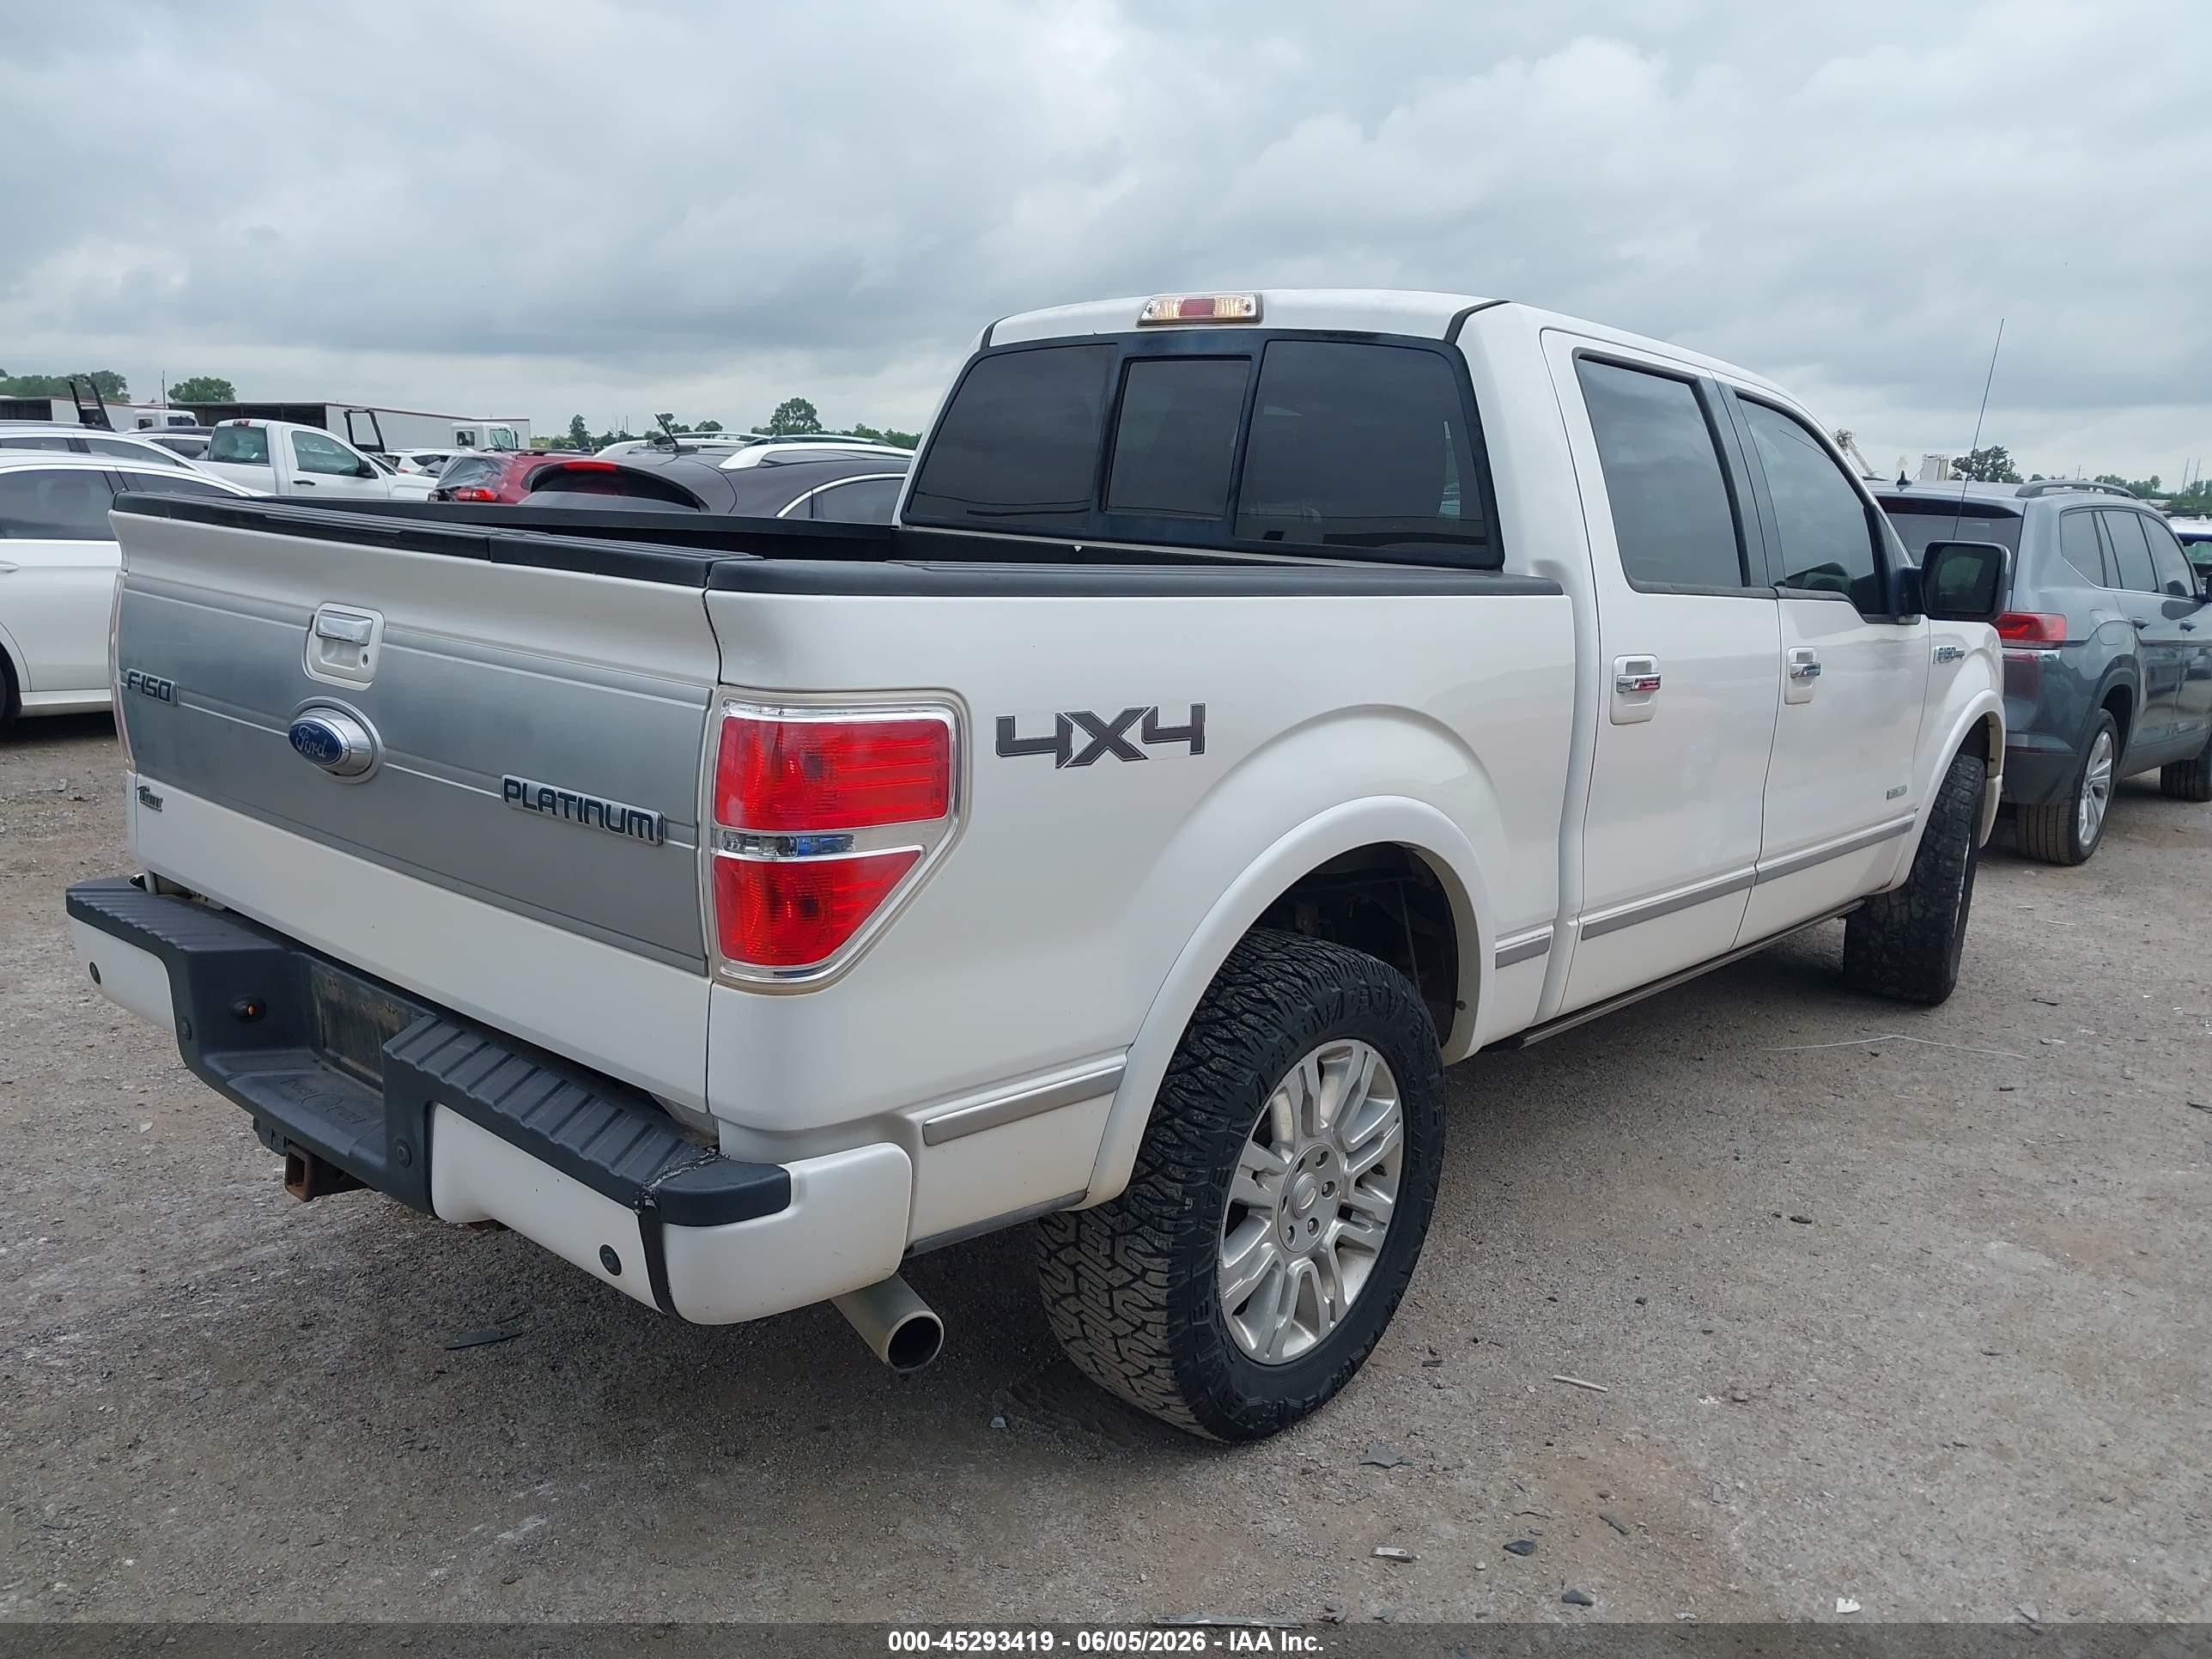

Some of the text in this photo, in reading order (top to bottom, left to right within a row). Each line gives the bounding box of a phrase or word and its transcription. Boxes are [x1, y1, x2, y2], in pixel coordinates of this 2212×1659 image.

[127, 670, 173, 702] F-150
[294, 723, 330, 759] Ford
[503, 777, 655, 842] PLATINUM
